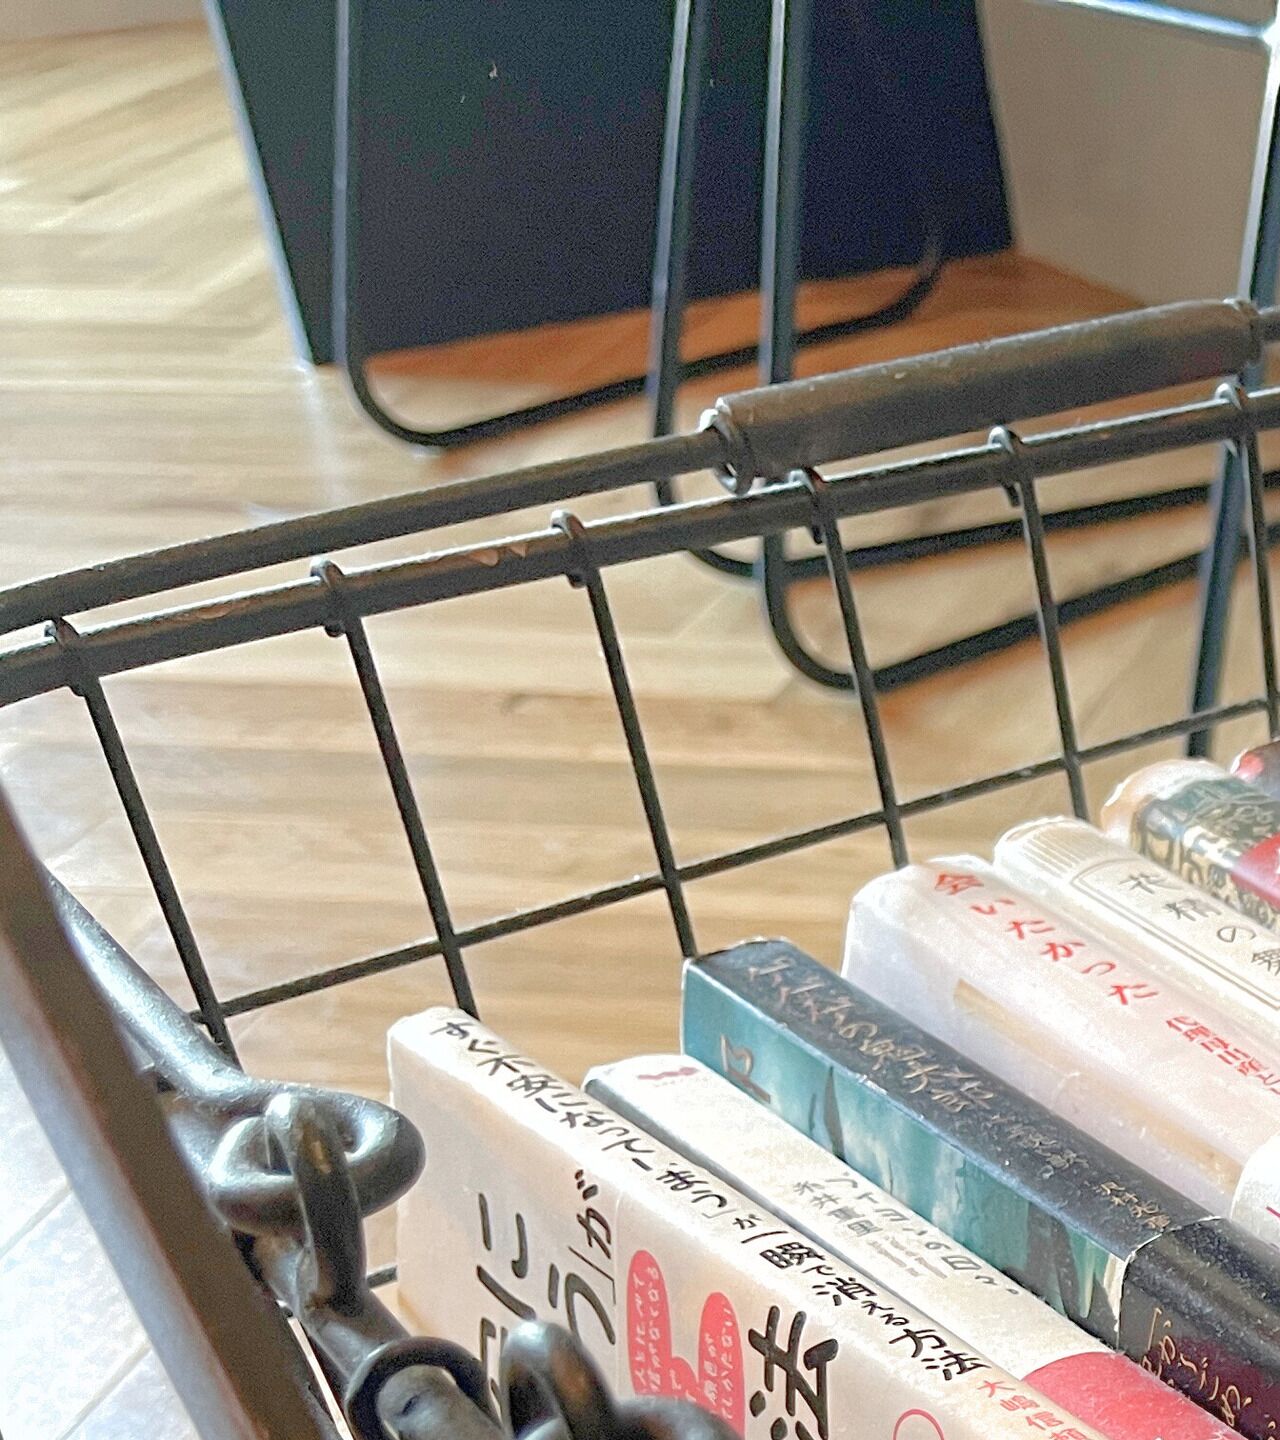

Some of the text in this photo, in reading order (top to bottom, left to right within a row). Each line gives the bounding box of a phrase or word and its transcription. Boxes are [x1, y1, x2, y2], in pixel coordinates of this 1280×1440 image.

[932, 870, 1161, 1007] 会いたかった
[793, 1180, 882, 1238] 糸井重里
